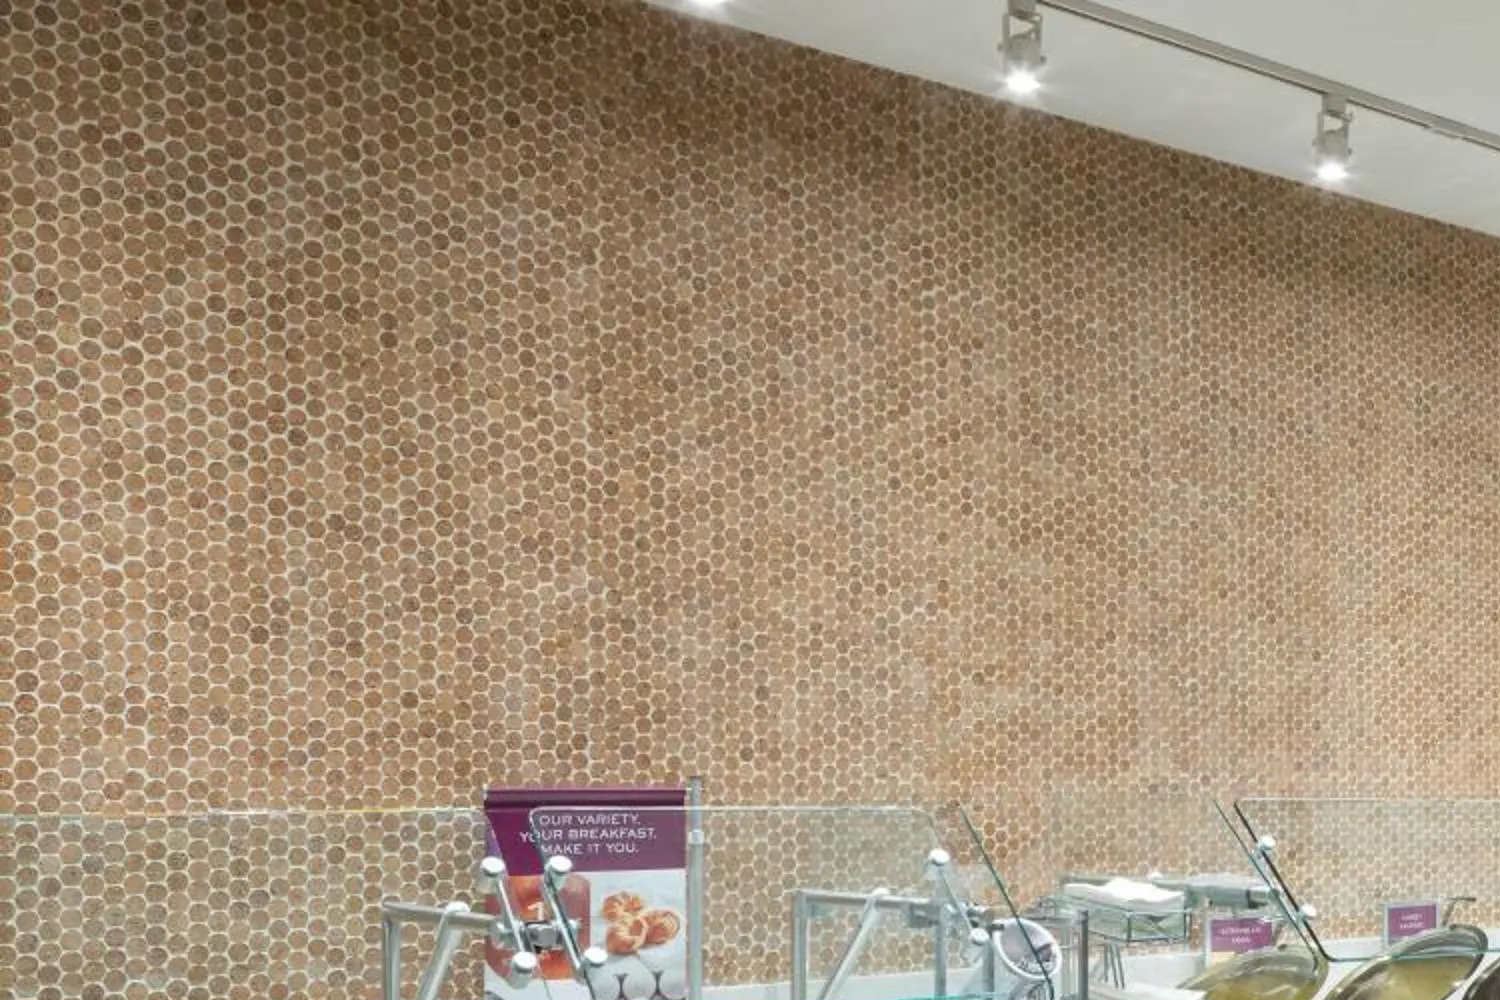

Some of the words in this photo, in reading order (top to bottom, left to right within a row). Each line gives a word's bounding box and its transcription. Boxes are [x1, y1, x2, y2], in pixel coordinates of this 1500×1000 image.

[539, 815, 572, 826] OUR
[576, 813, 641, 825] VARIETY.
[519, 828, 563, 843] YOUR
[567, 827, 657, 840] BREAKFAST.
[540, 843, 583, 855] MAKE
[587, 843, 599, 854] IT
[605, 842, 640, 854] YOU.
